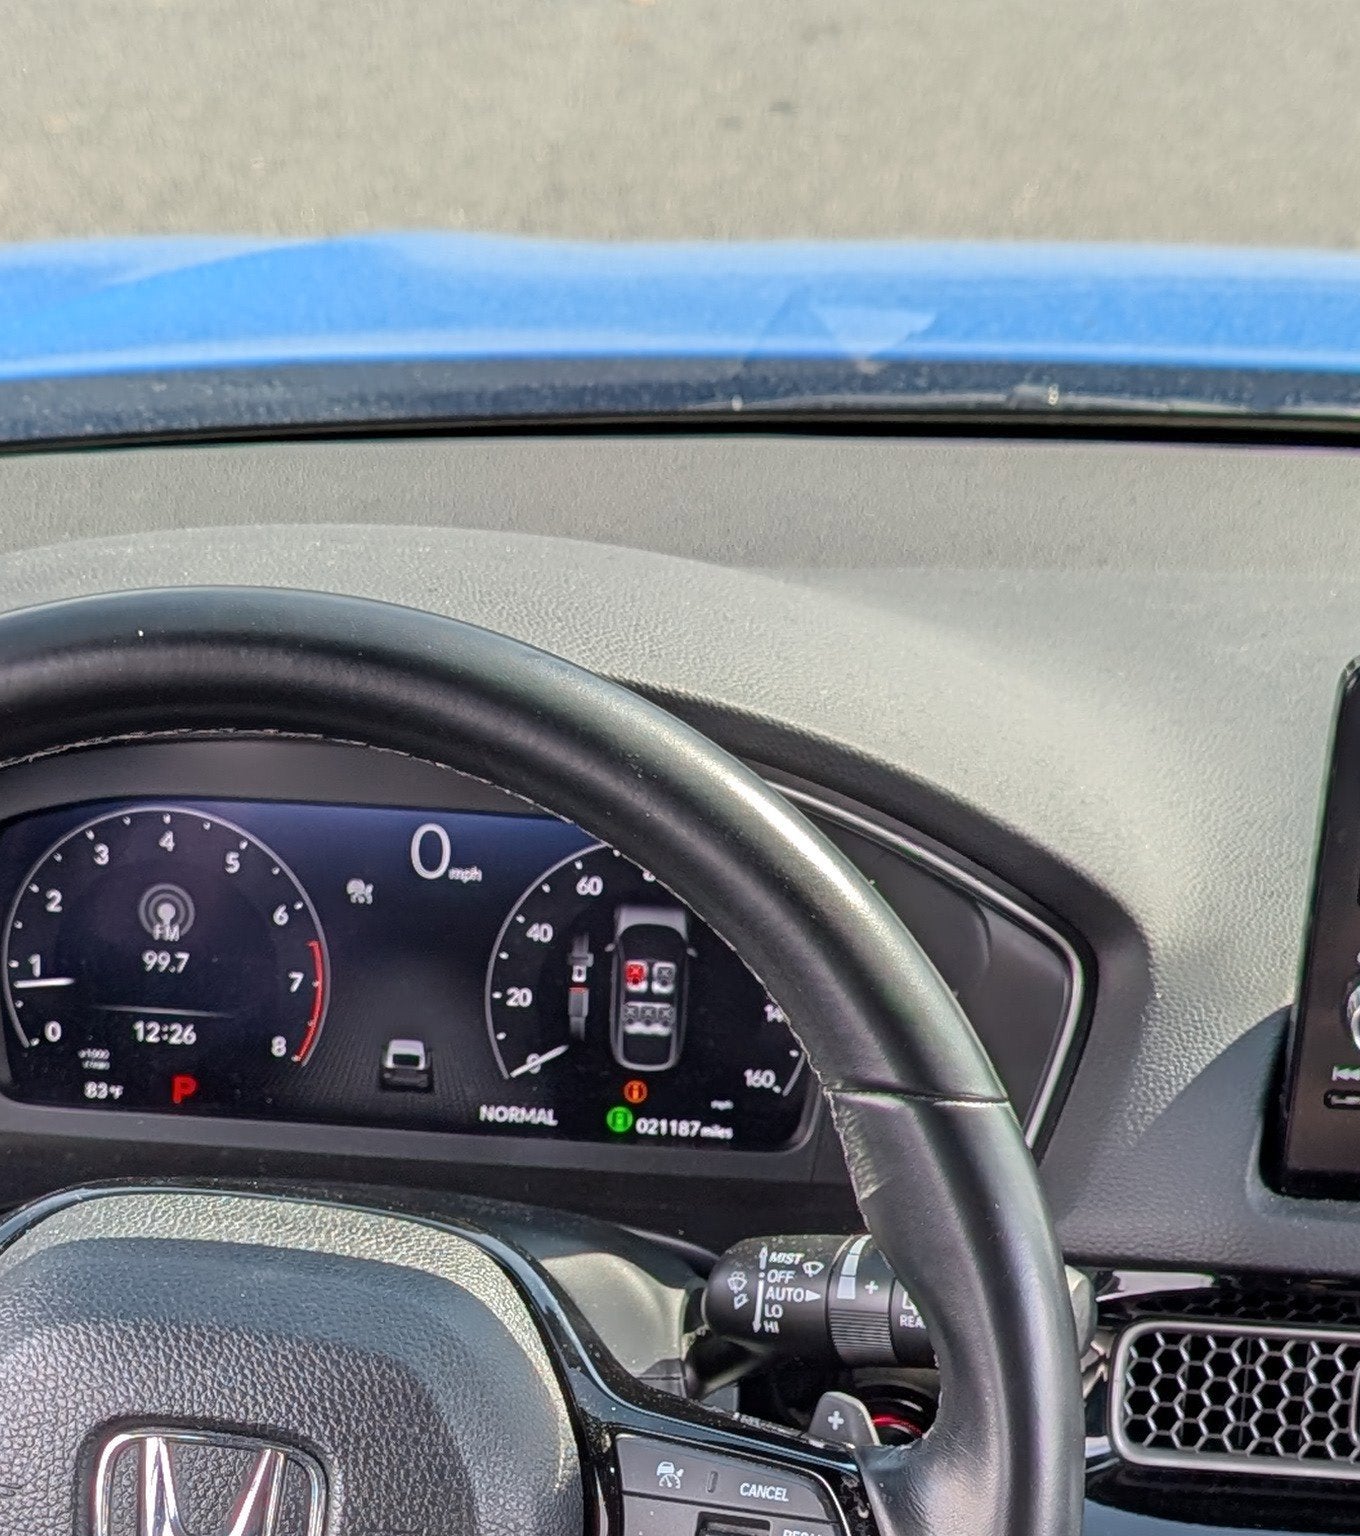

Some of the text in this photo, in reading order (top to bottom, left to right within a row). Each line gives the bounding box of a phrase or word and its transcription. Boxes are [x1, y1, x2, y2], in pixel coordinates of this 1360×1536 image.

[159, 831, 174, 852] 4
[93, 844, 110, 866] 3
[225, 851, 240, 873] 5
[411, 823, 482, 884] 0 mph
[576, 875, 603, 896] 60
[45, 892, 62, 913] 2
[272, 905, 288, 926] 6
[526, 923, 553, 943] 40
[29, 954, 41, 976] 1
[142, 950, 190, 974] 99.7
[288, 972, 304, 993] 7
[506, 988, 532, 1007] 20
[764, 1004, 783, 1022] 14
[45, 1021, 62, 1042] 0
[134, 1021, 197, 1046] 12:26
[271, 1036, 286, 1057] 8
[172, 1074, 197, 1103] P
[744, 1069, 776, 1089] 160
[479, 1104, 558, 1126] NORMAL
[636, 1117, 699, 1137] 021187
[769, 1252, 804, 1266] MIST
[767, 1270, 795, 1283] OFF
[765, 1288, 804, 1302] AUTO
[765, 1304, 784, 1318] LO
[900, 1313, 926, 1329] REA
[765, 1320, 779, 1333] HI
[740, 1483, 789, 1501] CANCEL
